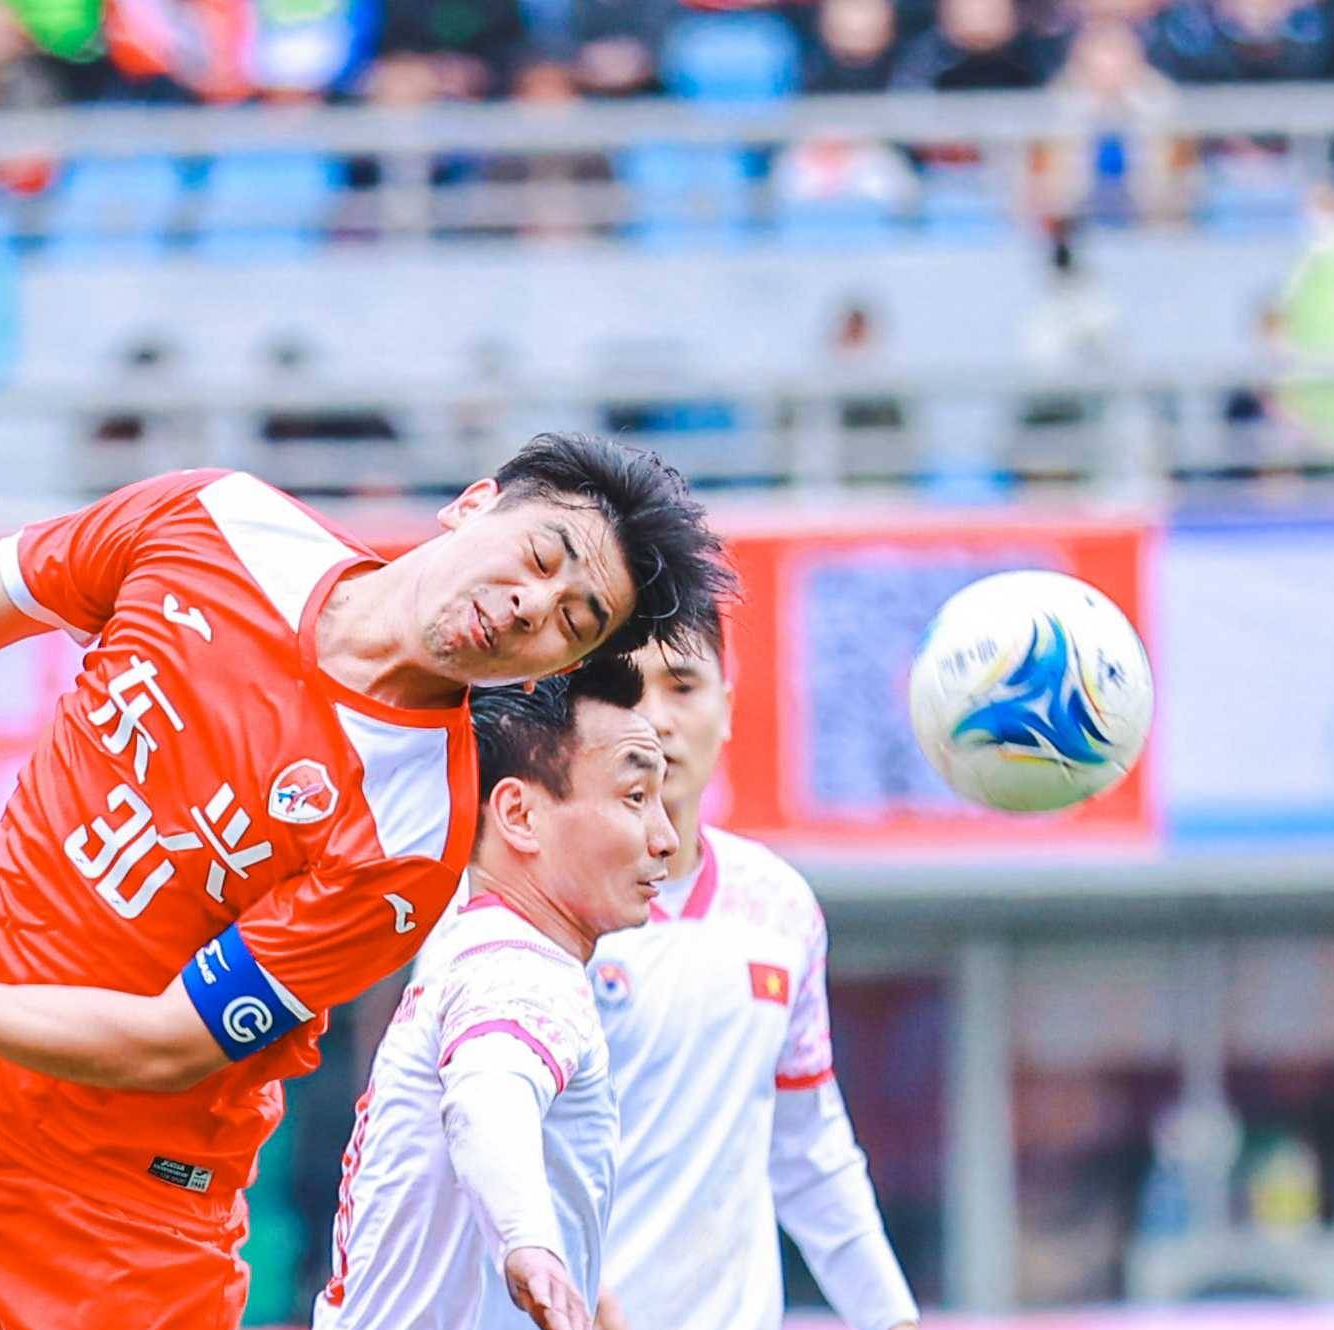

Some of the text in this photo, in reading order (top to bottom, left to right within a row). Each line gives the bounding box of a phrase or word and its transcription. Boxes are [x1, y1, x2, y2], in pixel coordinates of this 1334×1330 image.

[88, 655, 273, 904] 东兴
[63, 782, 175, 920] 30
[222, 995, 273, 1043] C
